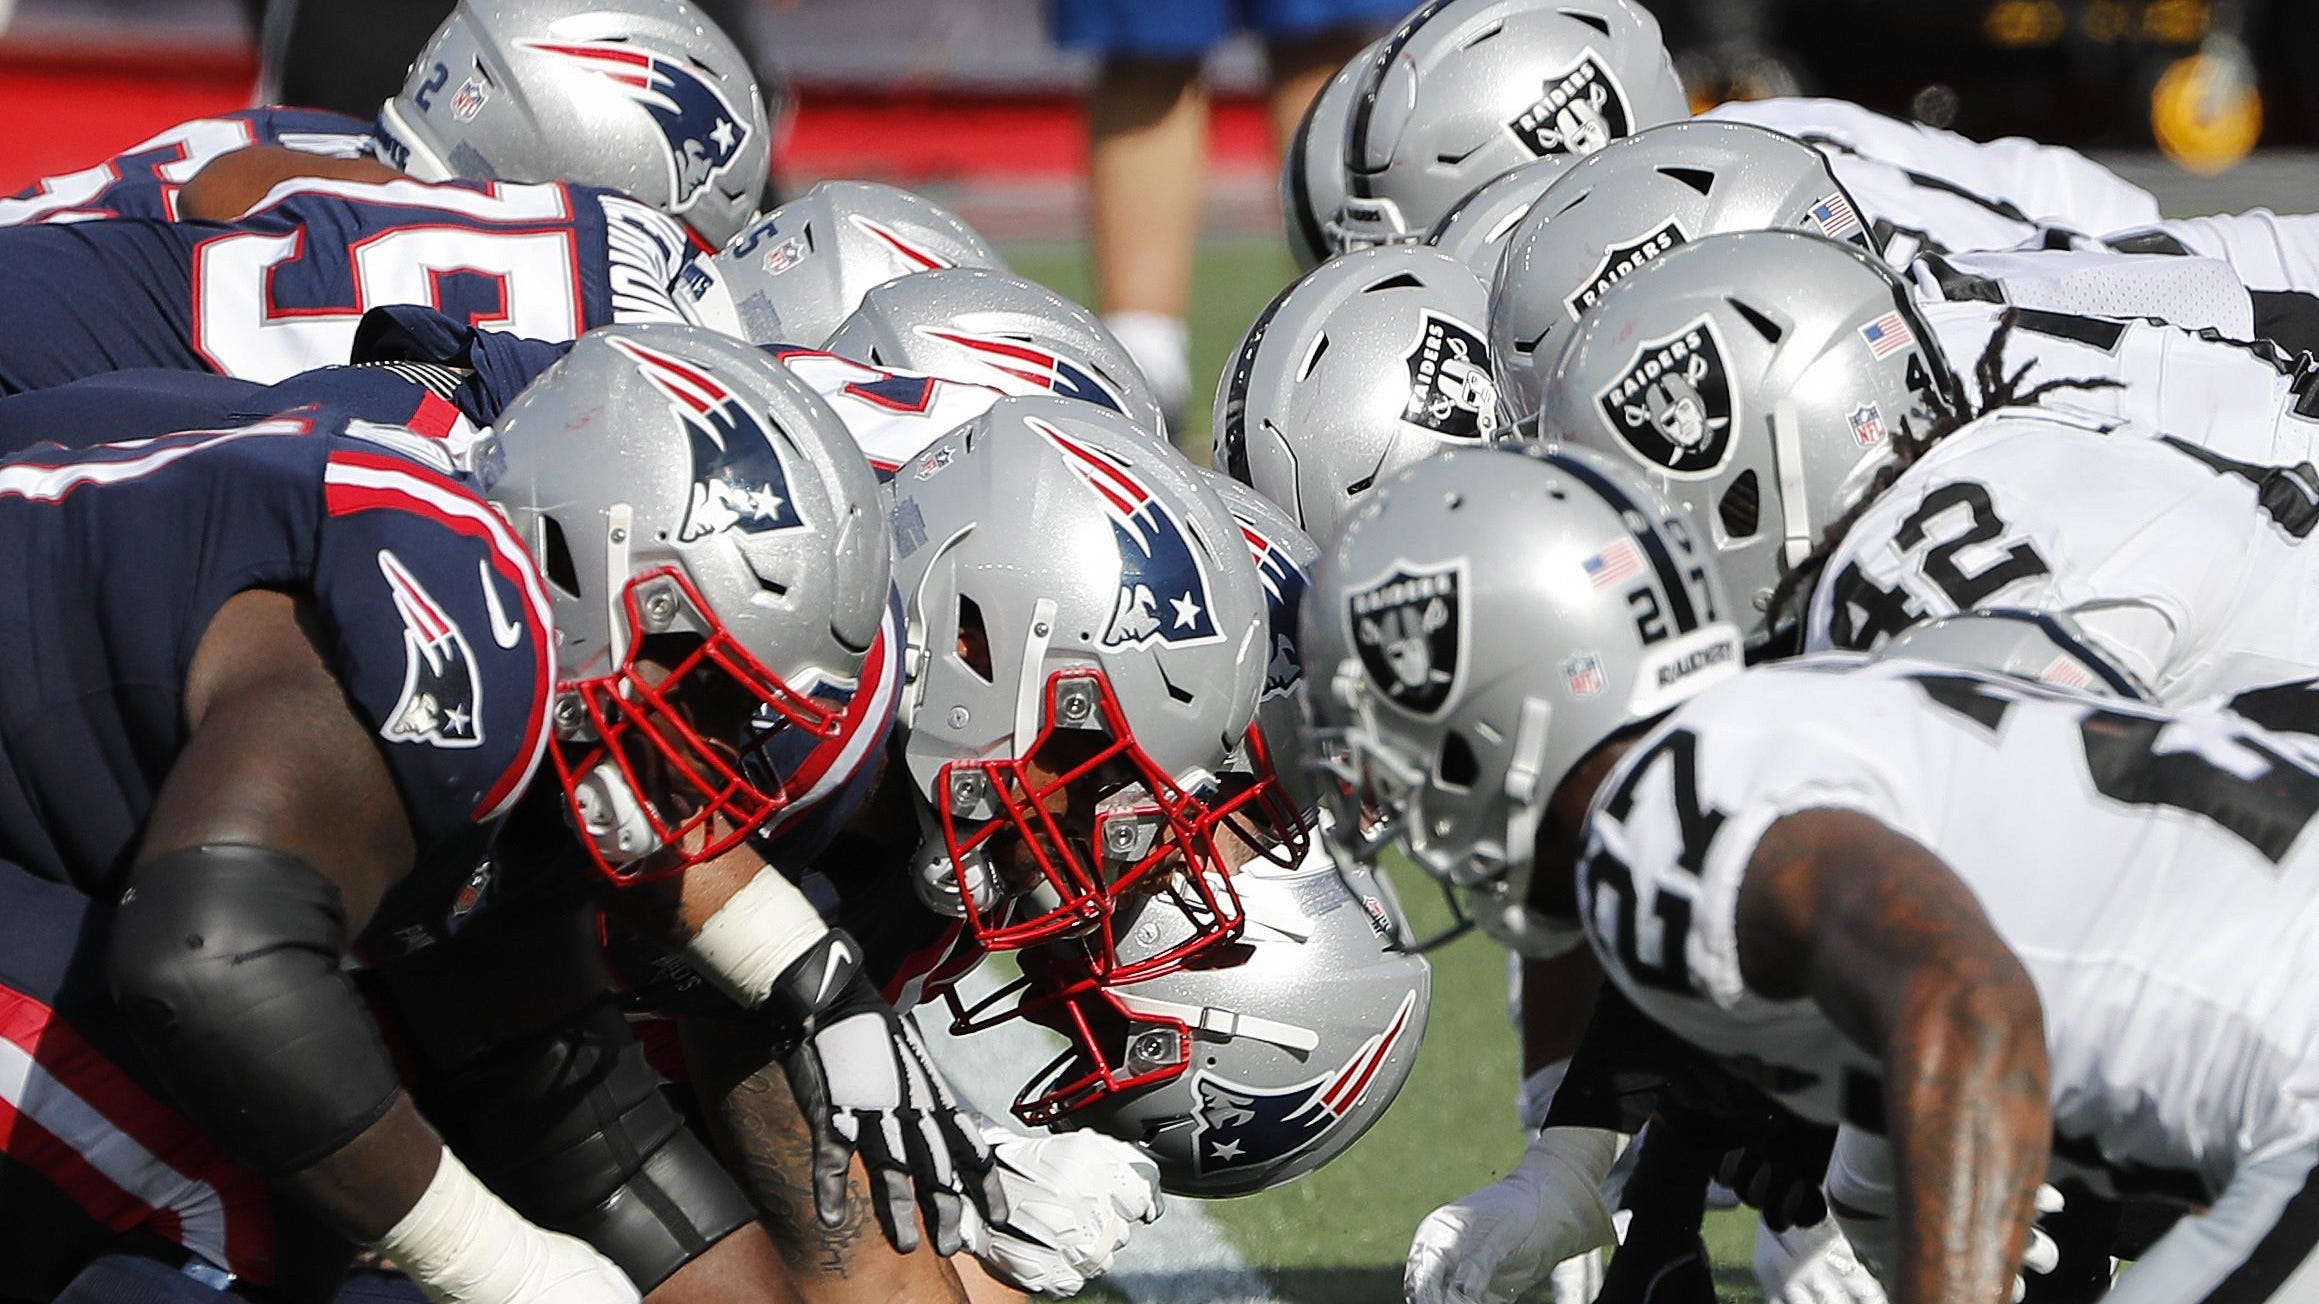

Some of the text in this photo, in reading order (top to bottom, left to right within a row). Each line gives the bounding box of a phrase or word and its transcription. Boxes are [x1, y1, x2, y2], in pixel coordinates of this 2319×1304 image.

[415, 61, 449, 113] 2
[1518, 61, 1596, 133] RAIDERS
[1582, 231, 1673, 308] RAIDERS
[1608, 330, 1703, 408] RAIDERS
[1829, 481, 2052, 653] 42
[1587, 727, 1728, 998] 27
